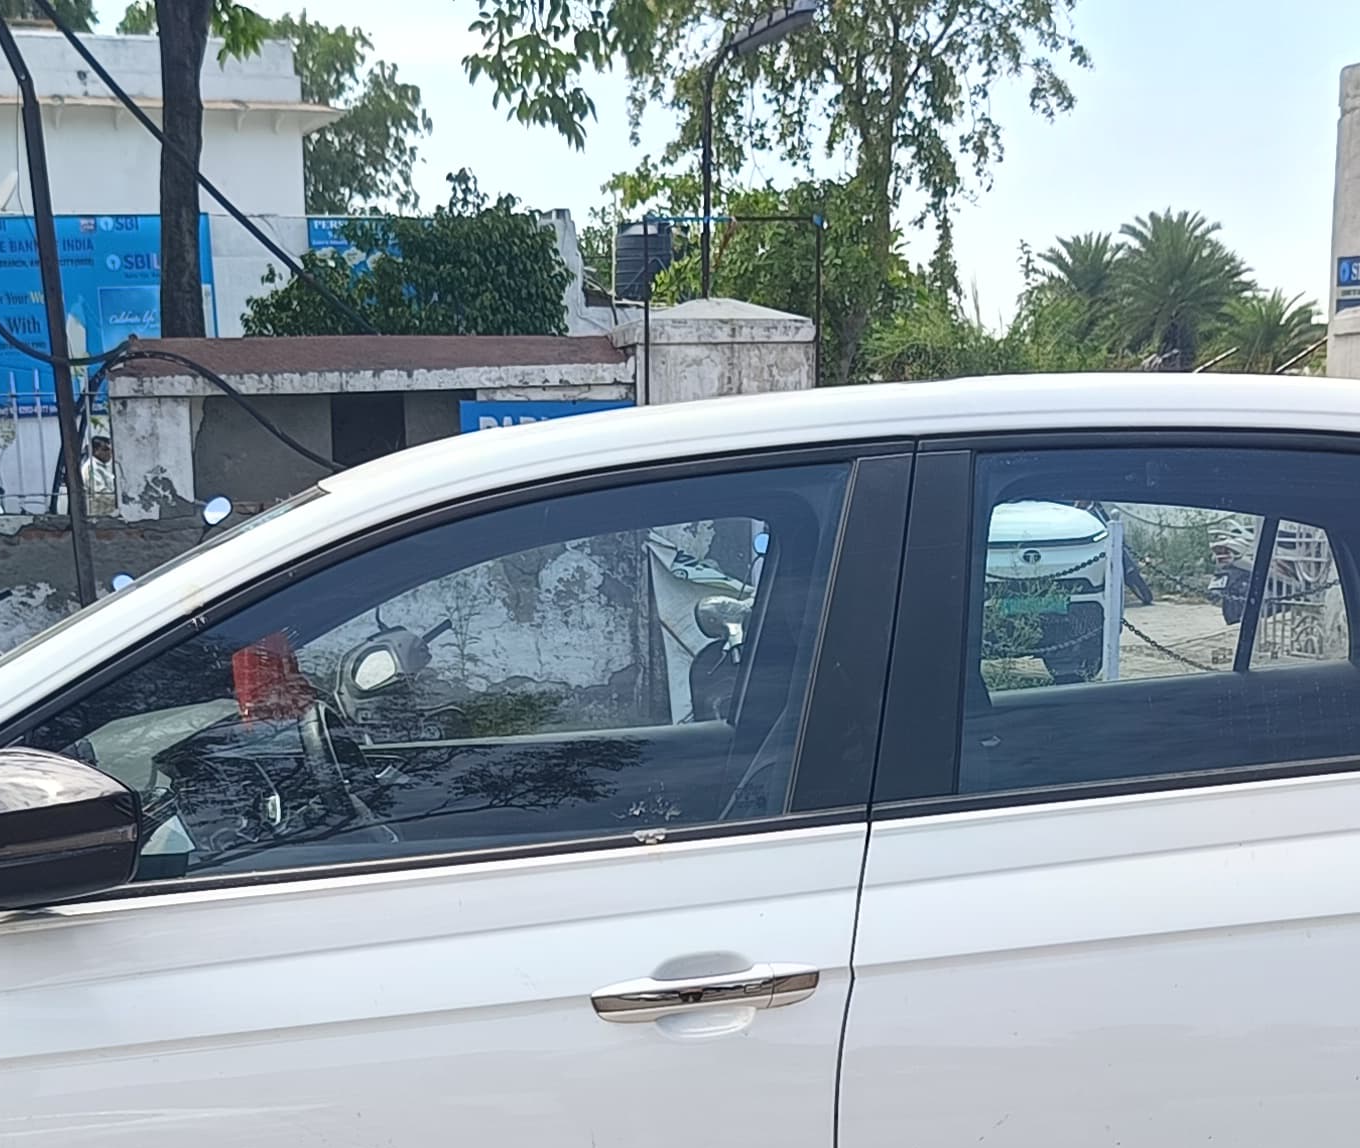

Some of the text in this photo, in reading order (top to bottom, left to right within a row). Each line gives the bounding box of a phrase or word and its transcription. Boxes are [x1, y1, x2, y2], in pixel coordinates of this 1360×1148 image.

[115, 216, 139, 231] SBI
[62, 239, 94, 252] INDIA
[122, 254, 152, 270] SBI
[6, 315, 41, 335] With
